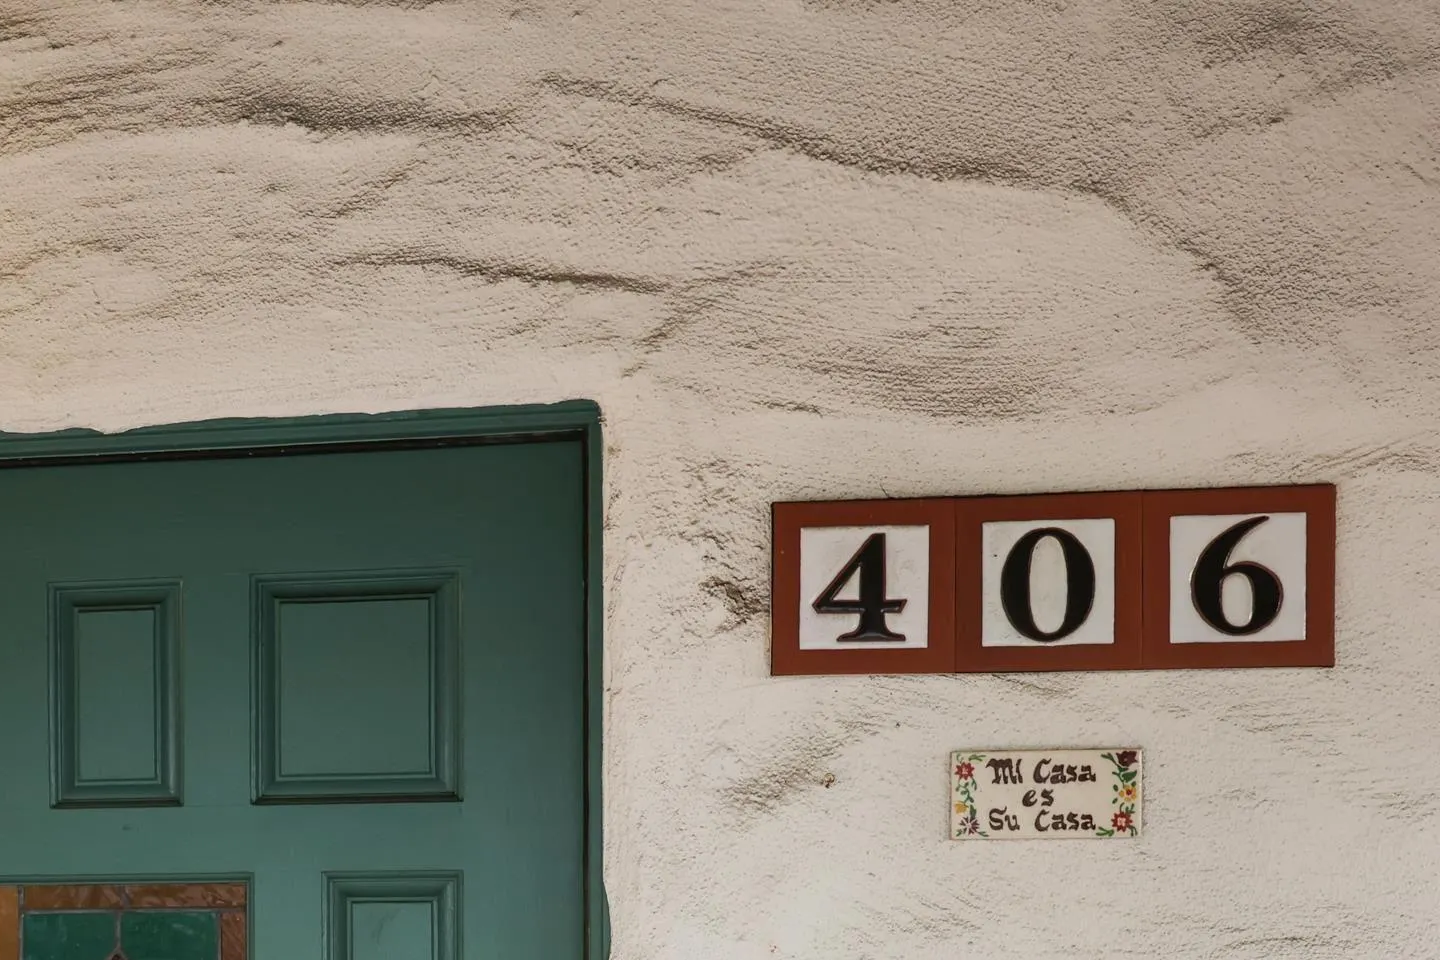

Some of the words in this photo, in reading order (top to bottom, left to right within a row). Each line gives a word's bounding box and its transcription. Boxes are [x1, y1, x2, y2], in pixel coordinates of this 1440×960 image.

[985, 757, 1024, 785] Mi
[1032, 757, 1097, 785] Casa
[1021, 788, 1055, 807] es
[988, 806, 1021, 831] Su
[1034, 808, 1097, 832] Casa
